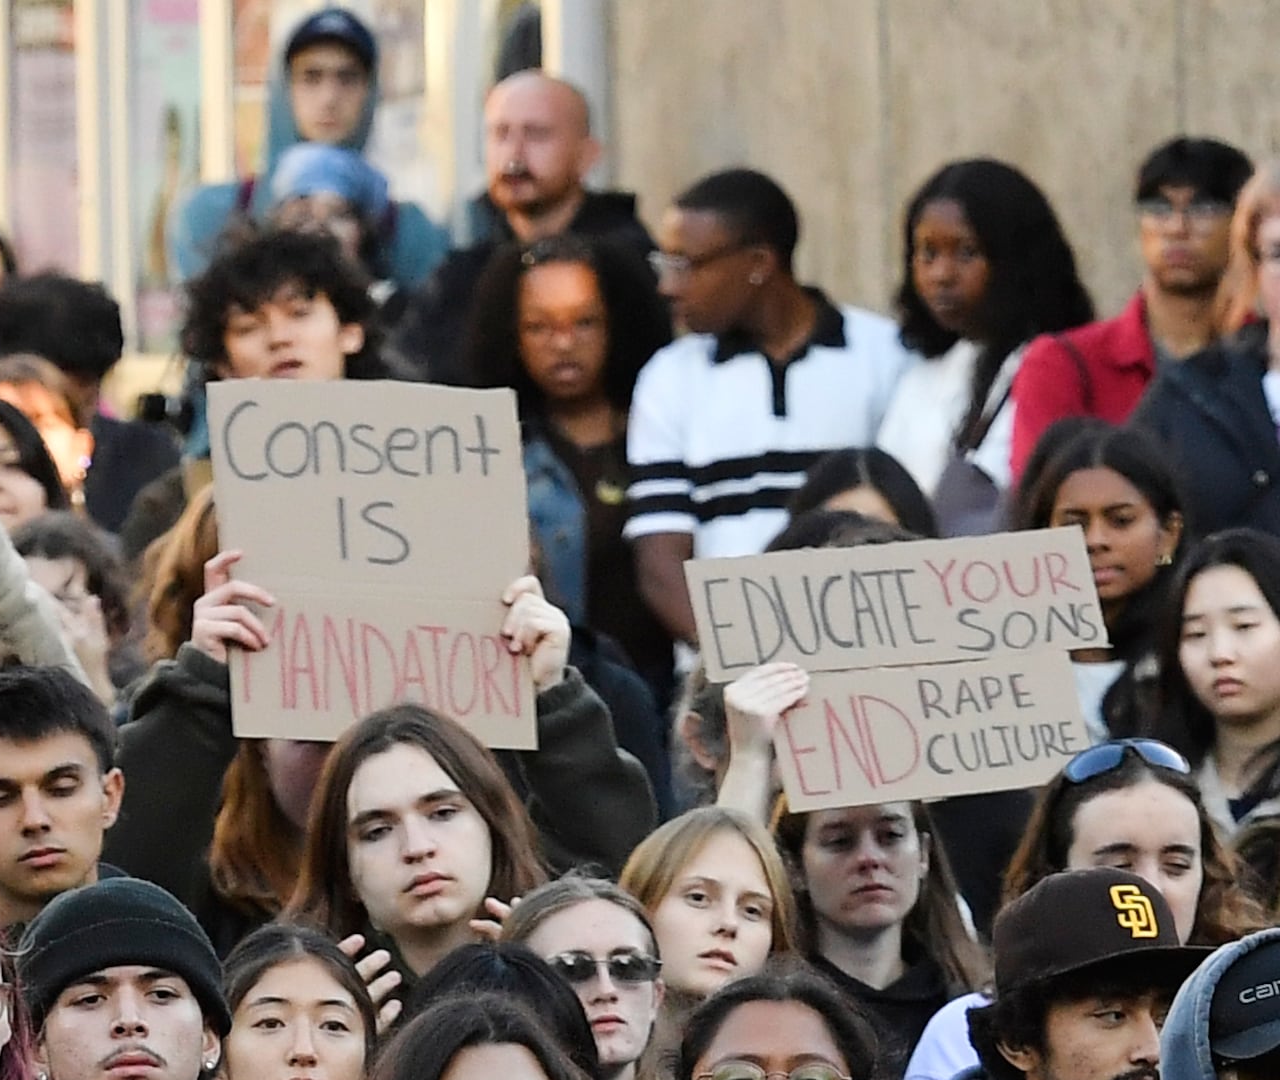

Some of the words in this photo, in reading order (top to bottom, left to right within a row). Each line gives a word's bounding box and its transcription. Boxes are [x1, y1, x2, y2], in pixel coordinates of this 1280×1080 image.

[223, 401, 500, 481] Consent
[338, 498, 409, 564] IS
[924, 553, 1081, 606] YOUR
[704, 569, 935, 669] EDUCATE
[958, 603, 1098, 651] SONS
[919, 674, 1035, 718] RAPE
[779, 694, 920, 795] END
[926, 722, 1084, 775] CULTURE
[1110, 884, 1158, 938] SD
